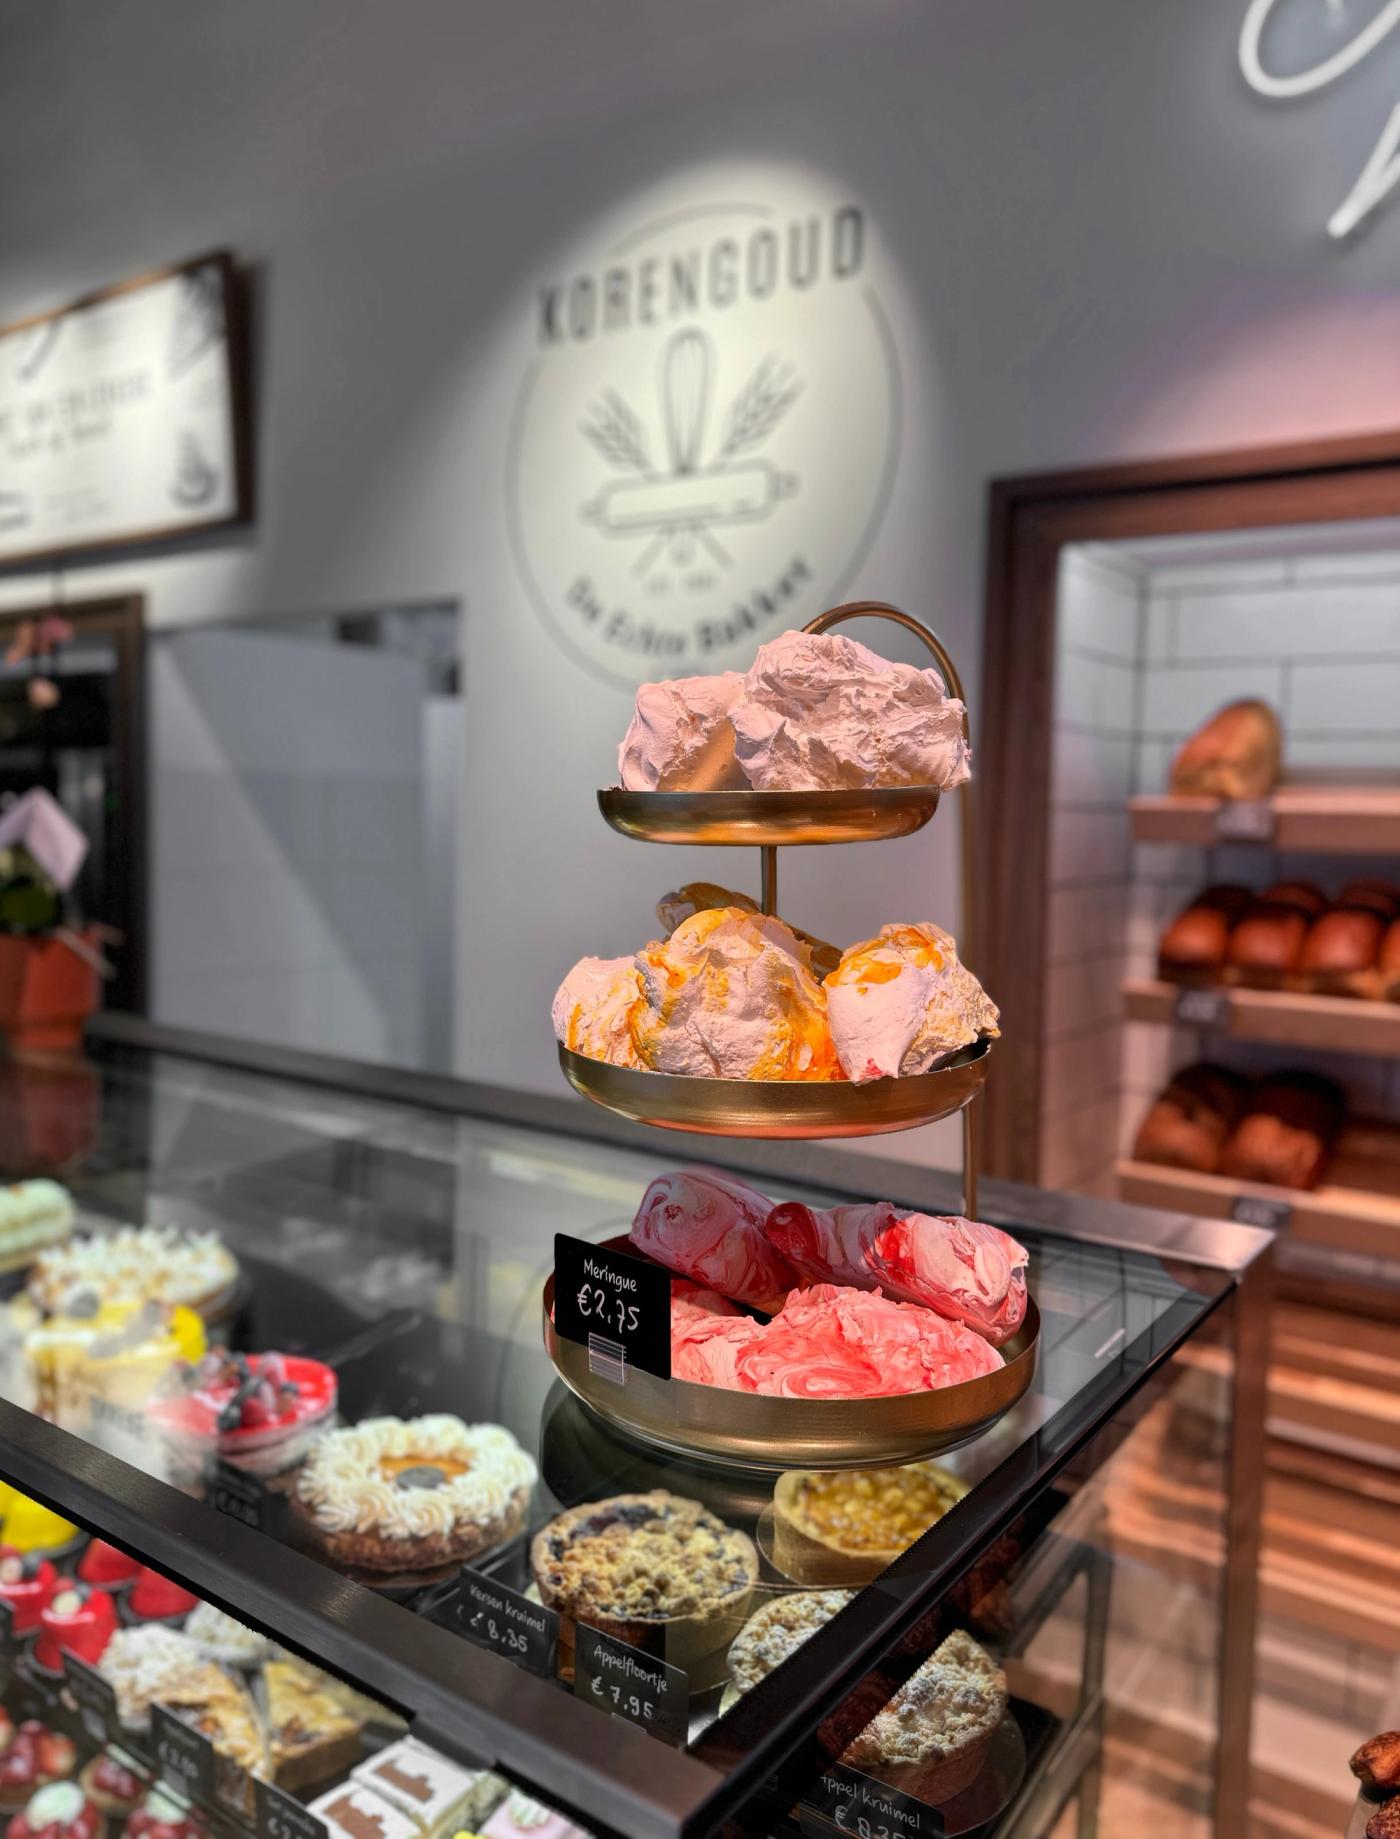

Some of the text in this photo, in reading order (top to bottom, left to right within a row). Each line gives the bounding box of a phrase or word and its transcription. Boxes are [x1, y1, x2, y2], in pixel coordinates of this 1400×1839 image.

[537, 203, 865, 349] KORENGOUD
[583, 1258, 637, 1293] Meringue
[504, 1599, 546, 1632] kruimel
[862, 1787, 920, 1829] kruimel
